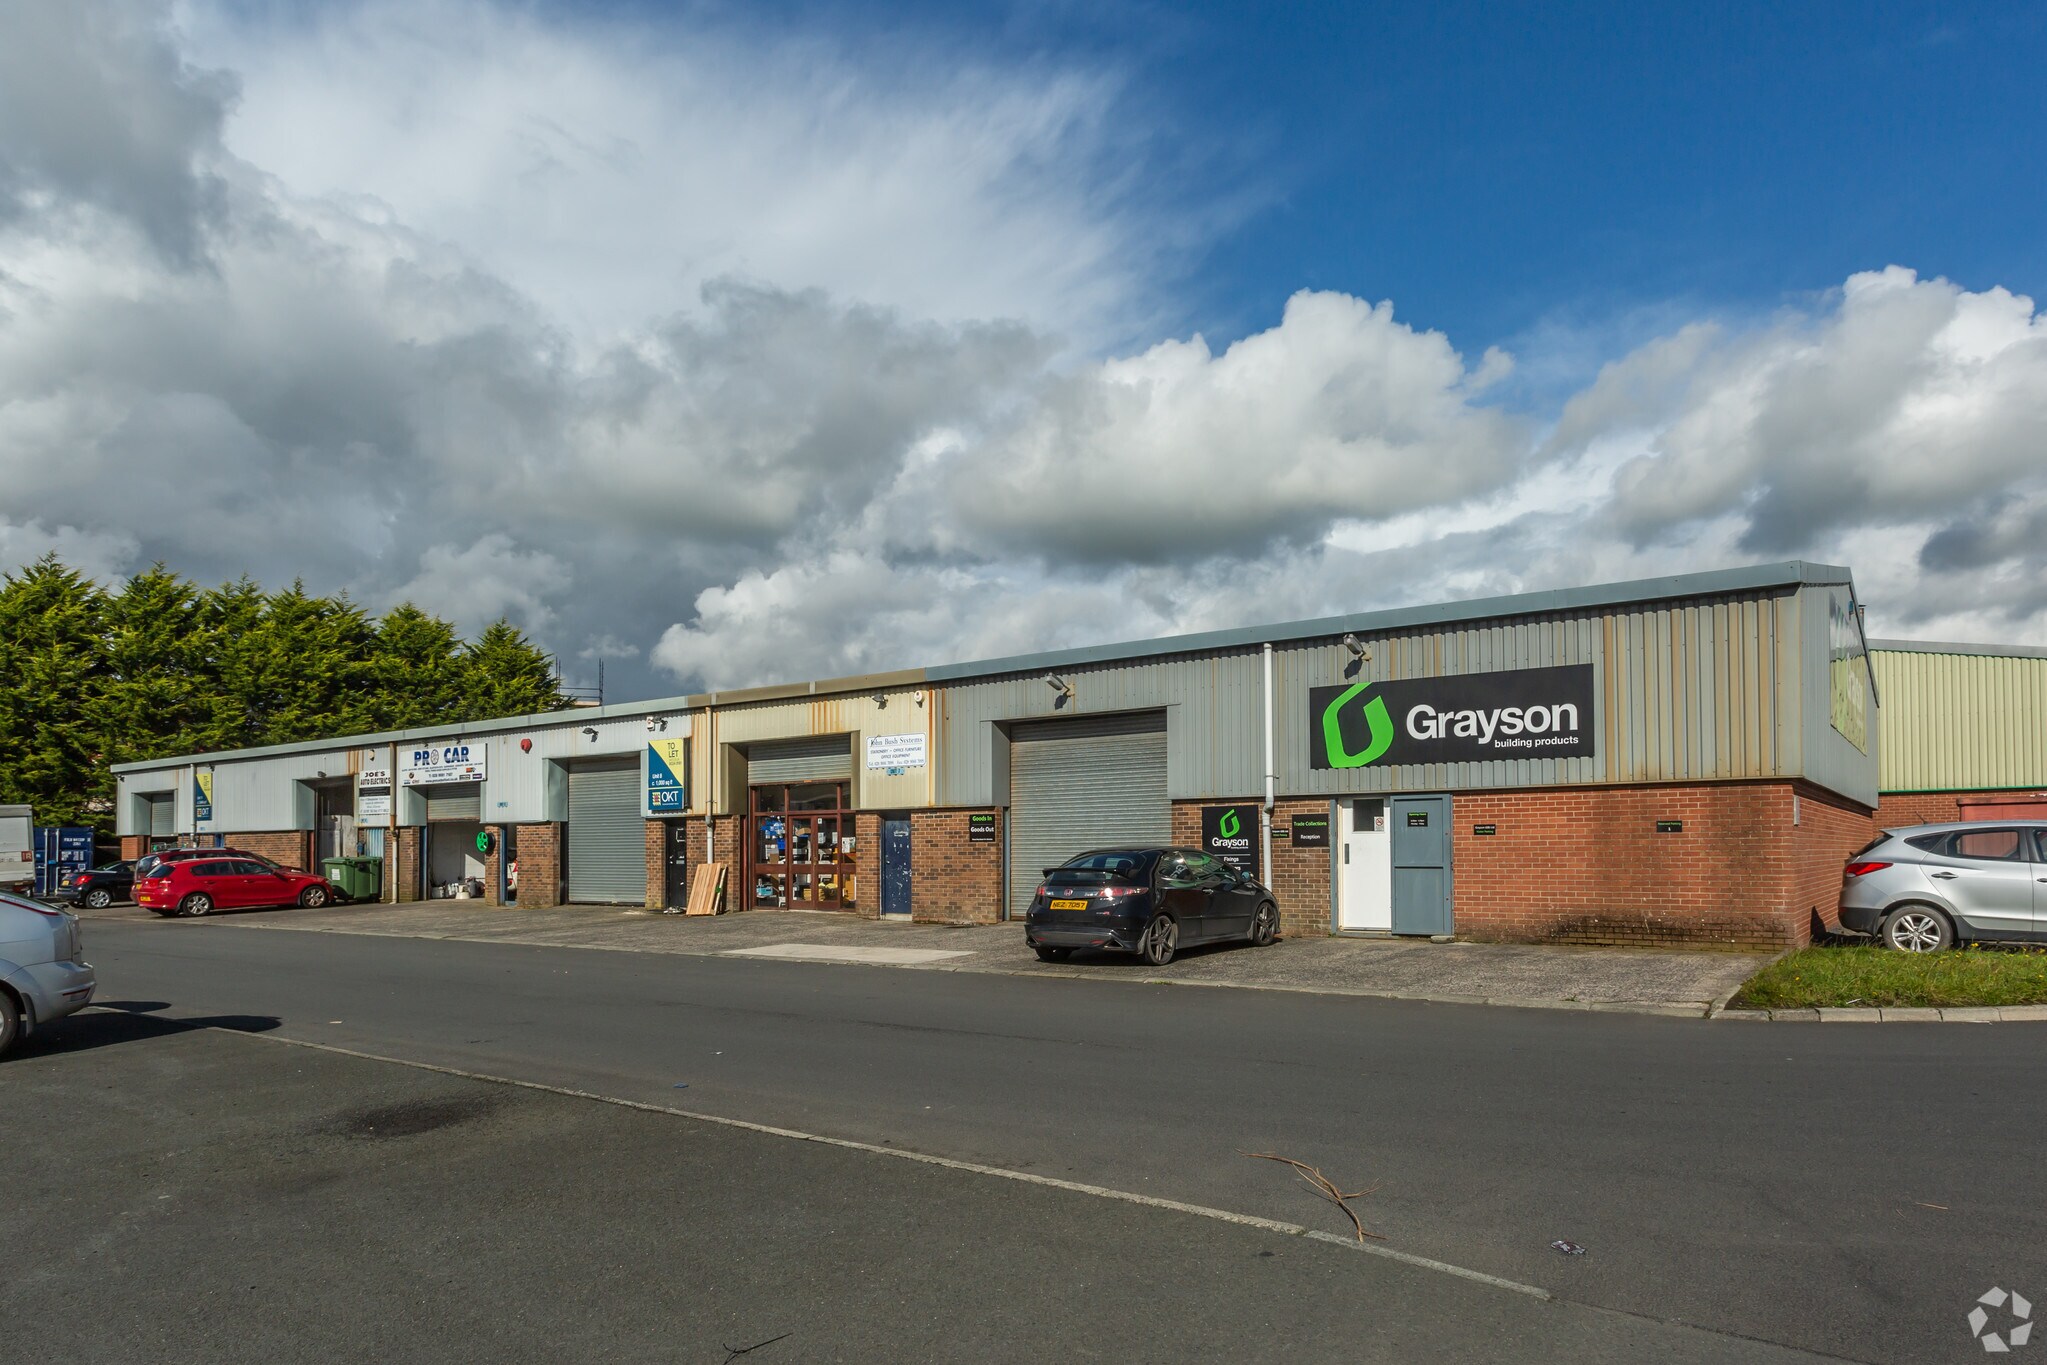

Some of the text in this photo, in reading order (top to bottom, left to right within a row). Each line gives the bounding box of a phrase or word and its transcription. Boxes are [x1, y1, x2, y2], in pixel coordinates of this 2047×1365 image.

[1406, 703, 1578, 744] Grayson
[668, 742, 675, 750] TO
[1495, 736, 1578, 748] building products
[444, 746, 470, 763] CAR
[669, 750, 678, 758] LET
[370, 777, 391, 785] ELECTRICS
[662, 791, 678, 802] OKT
[1212, 837, 1248, 848] Grayson
